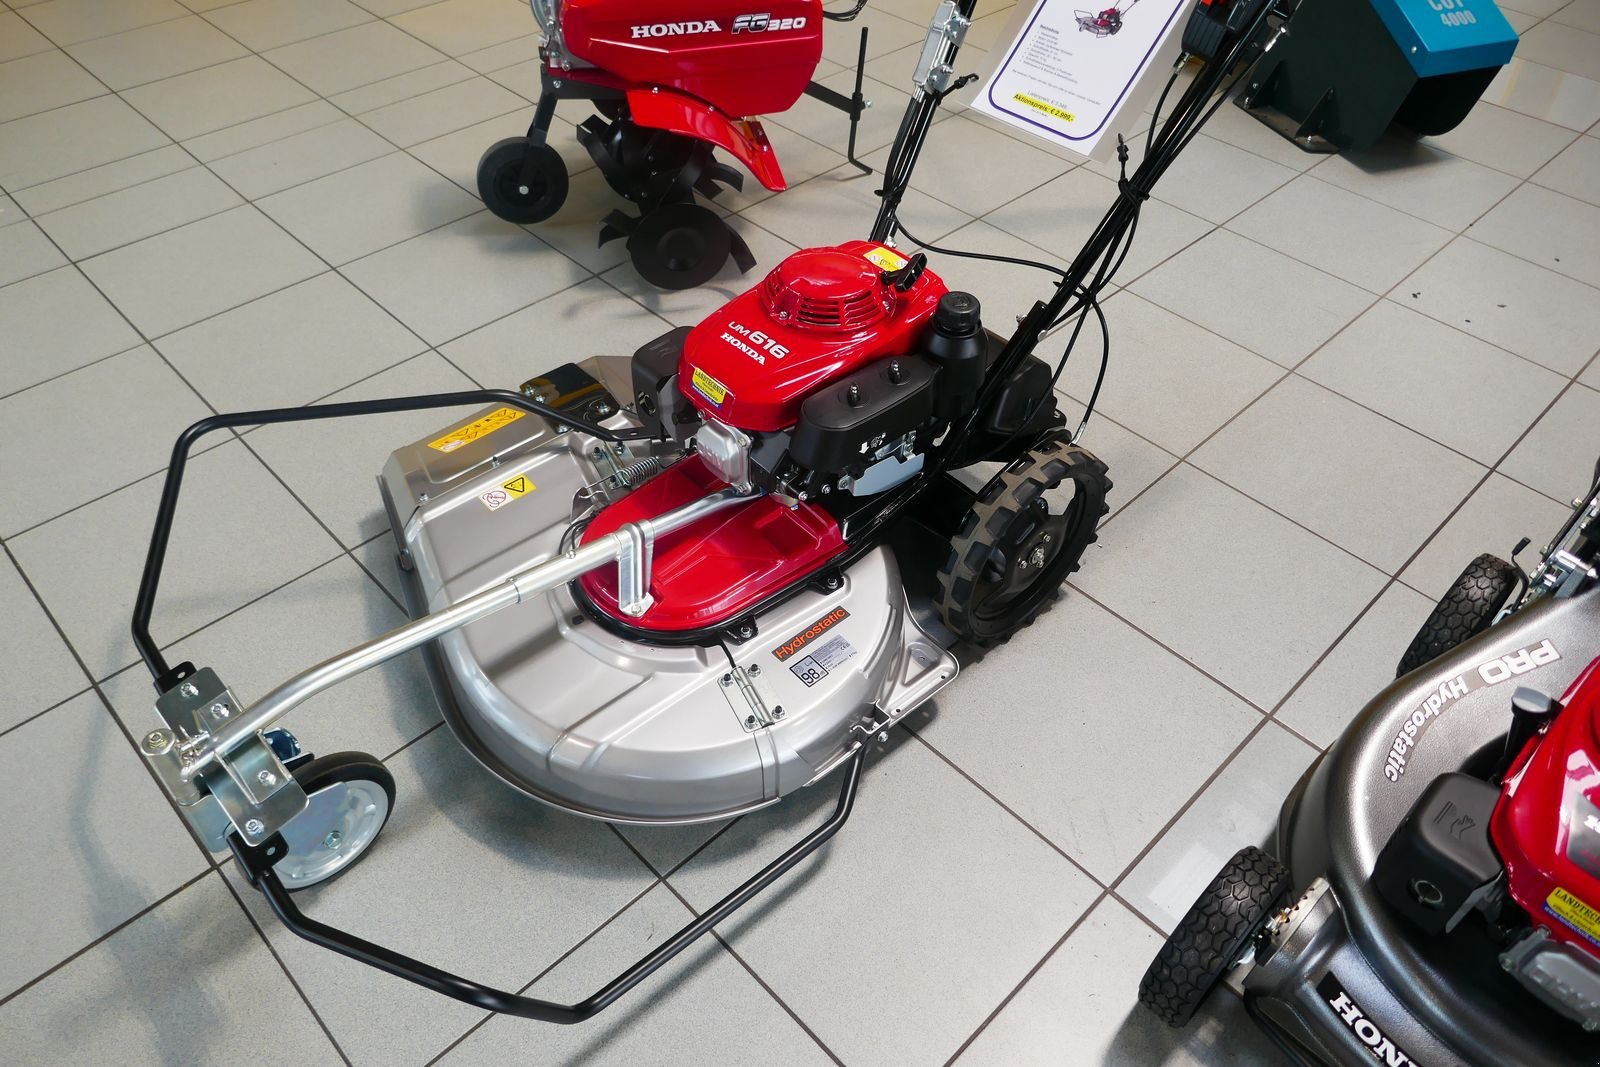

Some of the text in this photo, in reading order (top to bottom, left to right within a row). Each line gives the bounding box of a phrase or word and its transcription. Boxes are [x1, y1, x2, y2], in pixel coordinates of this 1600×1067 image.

[631, 19, 722, 39] HONDA
[1440, 10, 1477, 27] 4000
[720, 332, 766, 365] HONDA
[775, 609, 846, 659] Hydrostatic
[801, 668, 820, 684] 98
[1384, 638, 1561, 783] PRO Hydrostatic
[1329, 991, 1419, 1067] HON
